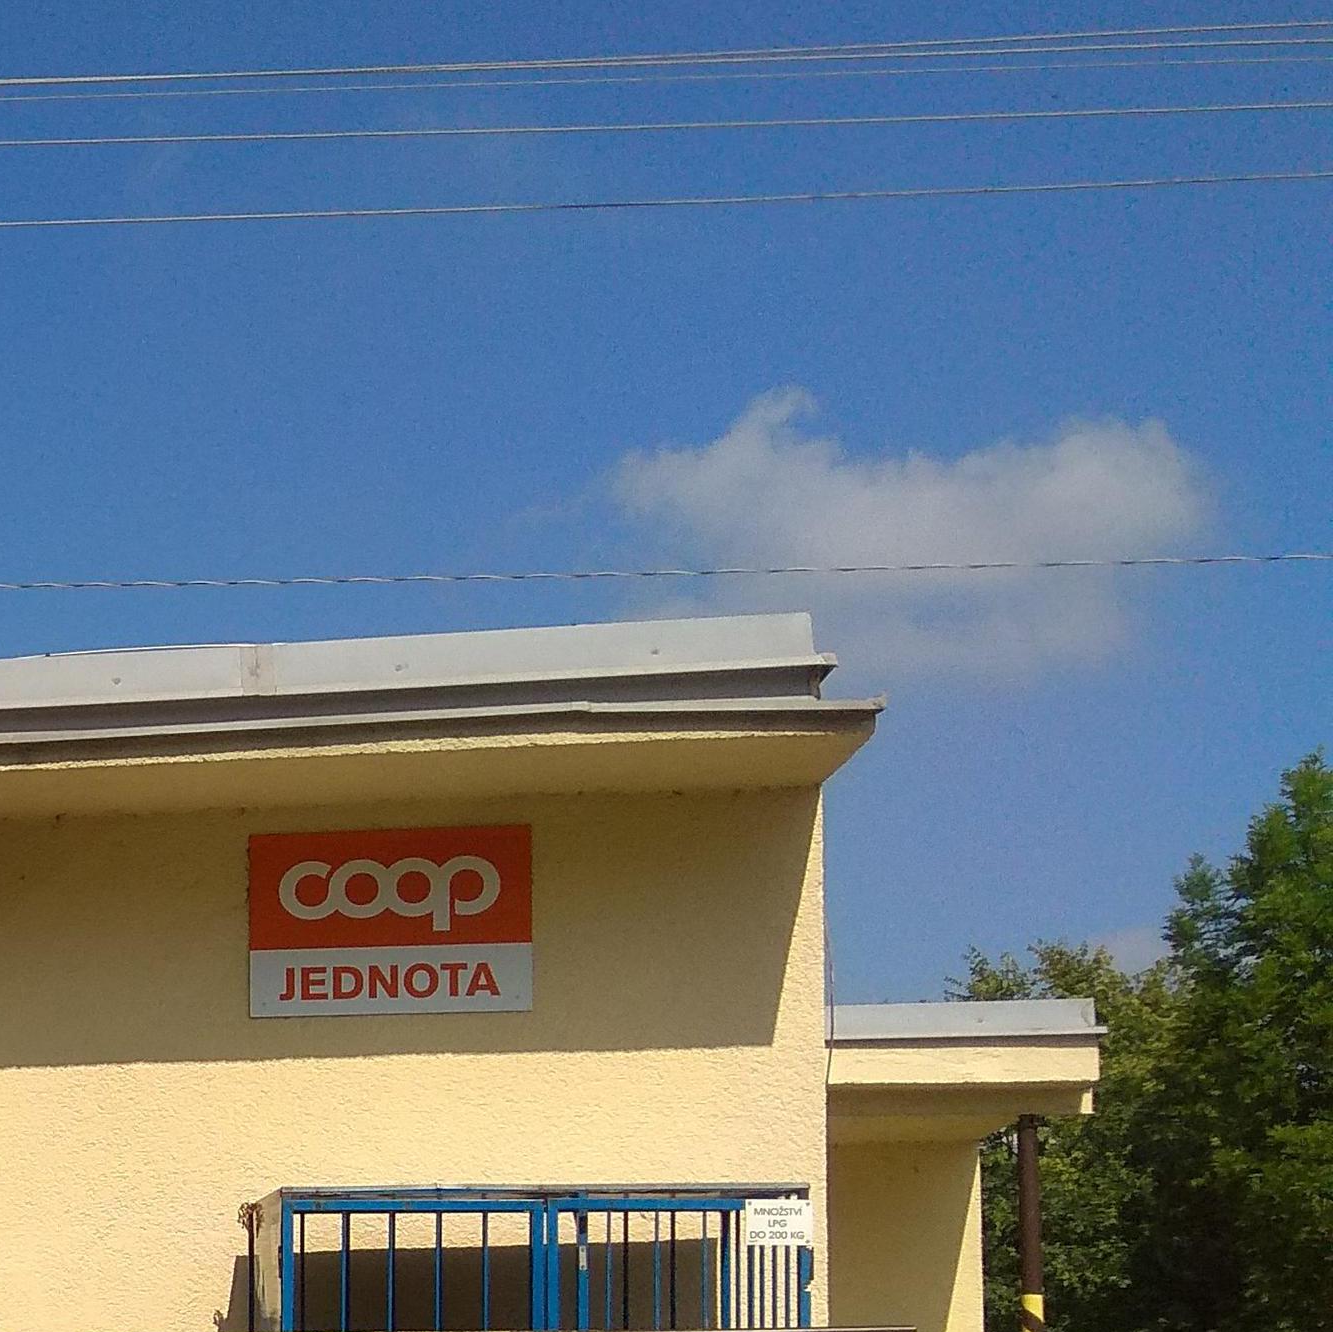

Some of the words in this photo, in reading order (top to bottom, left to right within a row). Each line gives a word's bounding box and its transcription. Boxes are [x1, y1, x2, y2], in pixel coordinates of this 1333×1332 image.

[279, 856, 501, 932] coop
[279, 962, 501, 1001] JEDNOTA
[753, 1205, 802, 1216] MNOŽSTVÍ
[767, 1219, 787, 1228] LPG
[749, 1230, 766, 1239] DO
[768, 1230, 788, 1240] 200
[790, 1231, 805, 1240] KG
